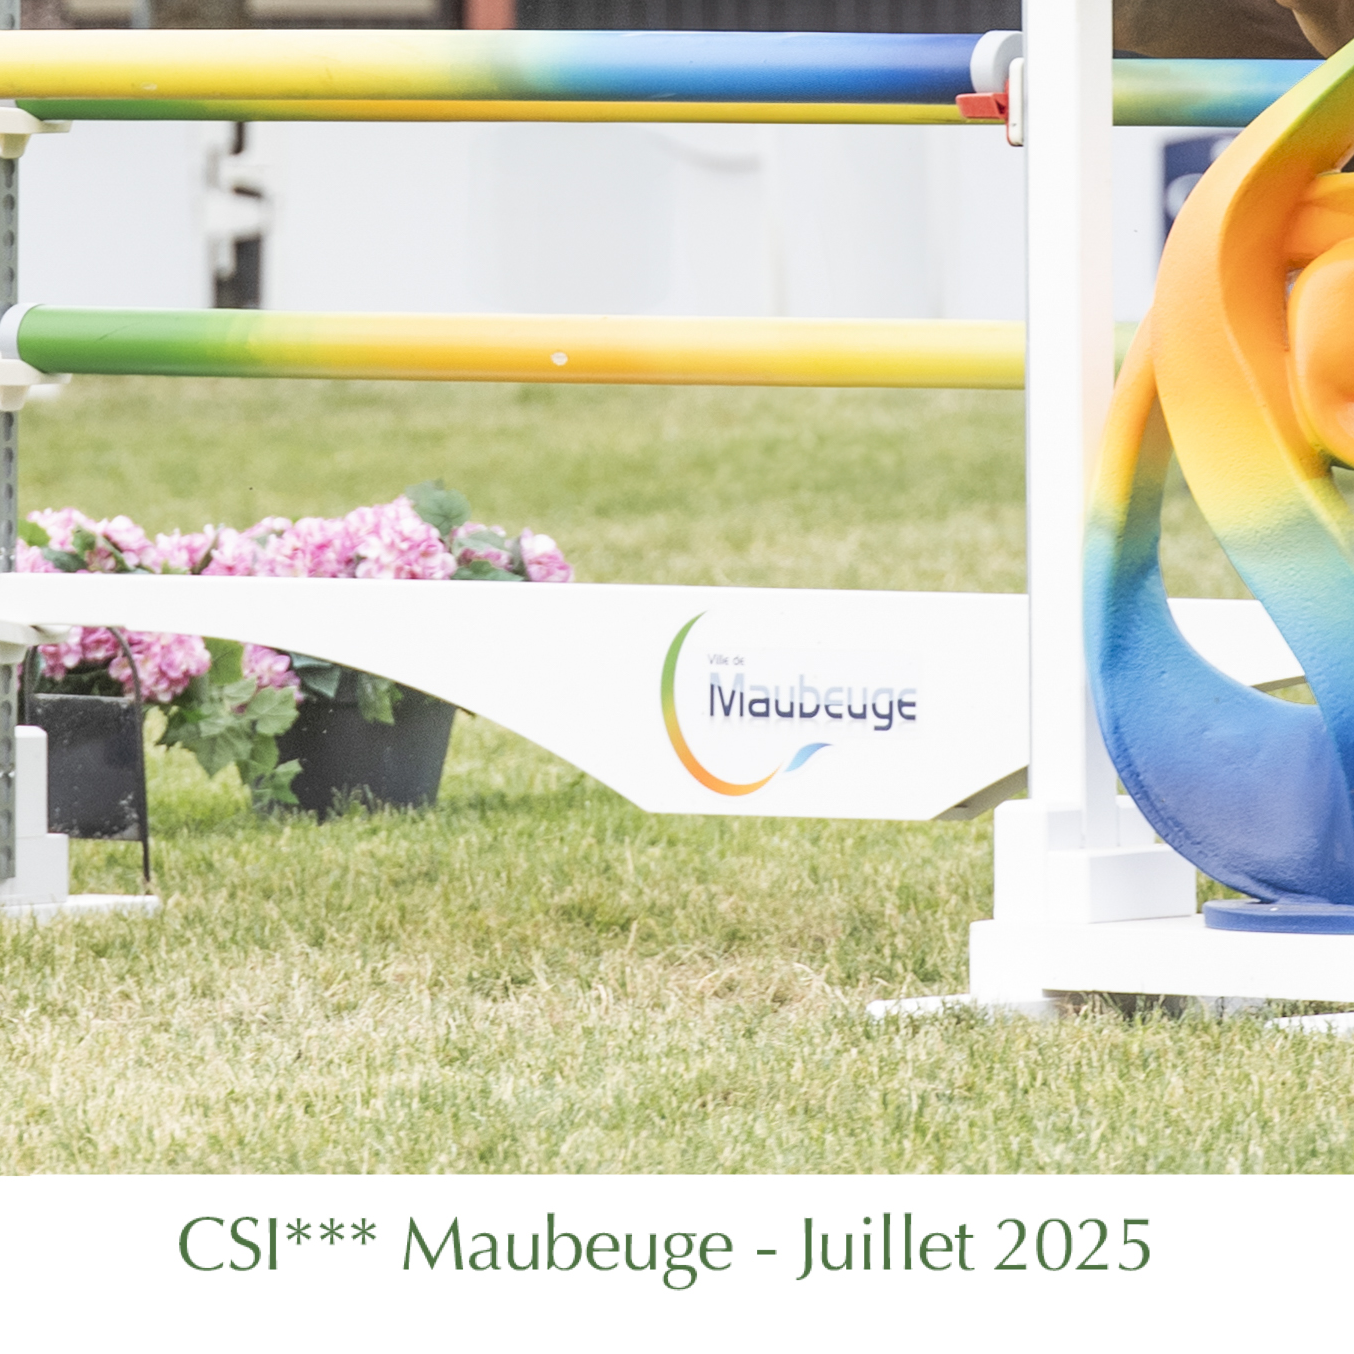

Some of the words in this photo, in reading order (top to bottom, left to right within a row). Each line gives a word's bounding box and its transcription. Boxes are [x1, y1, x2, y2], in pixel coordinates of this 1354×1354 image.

[708, 654, 729, 665] Ville
[733, 654, 744, 666] de
[709, 672, 917, 732] Maubeuge
